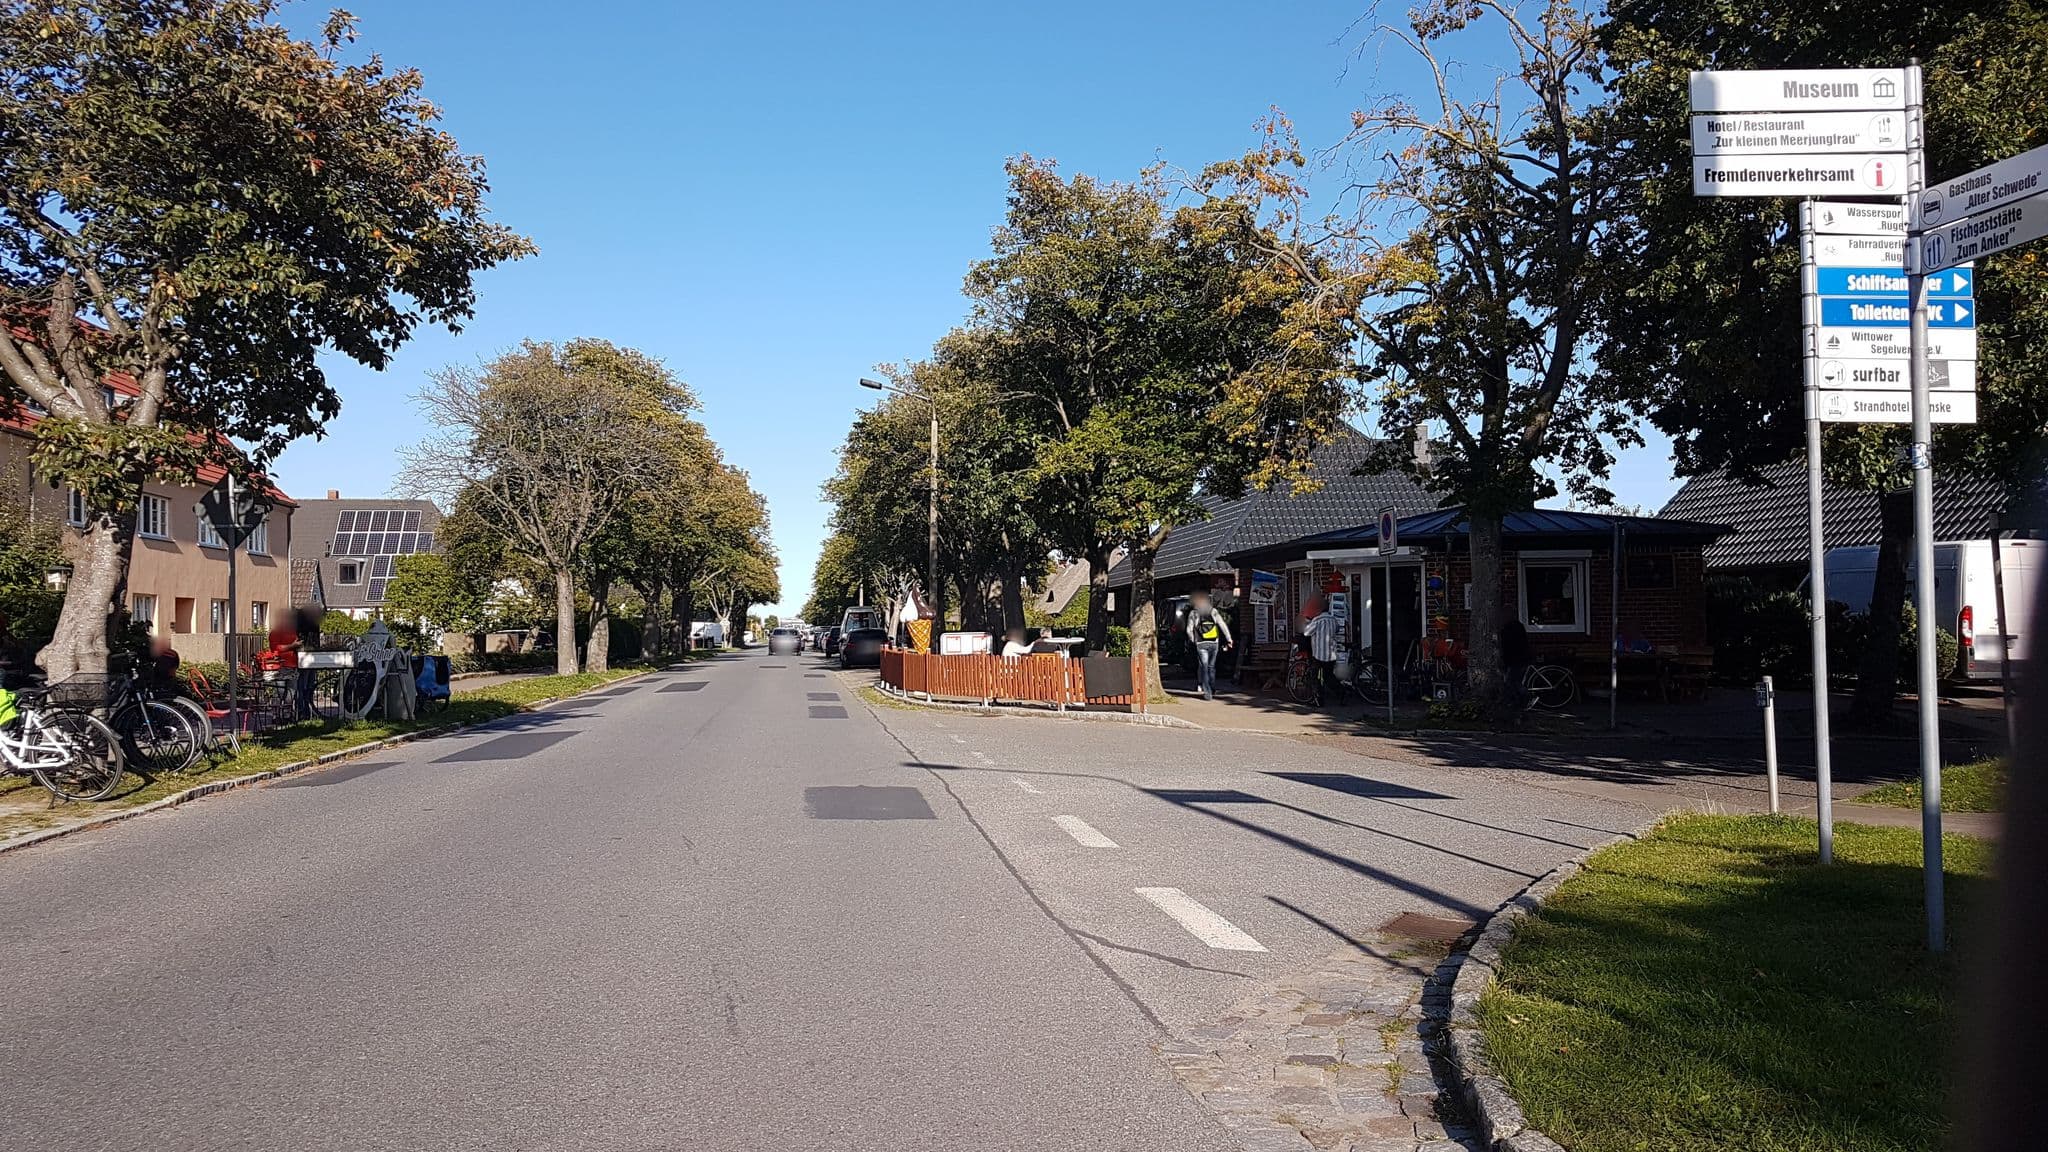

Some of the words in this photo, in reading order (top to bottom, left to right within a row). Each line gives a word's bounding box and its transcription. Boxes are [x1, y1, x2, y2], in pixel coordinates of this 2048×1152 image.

[1783, 81, 1859, 98] Museum
[1736, 135, 1778, 147] kleinen
[1704, 168, 1855, 183] Fremdenverkehrsamt
[1949, 173, 1992, 198] Gasthaus
[1847, 207, 1902, 219] Wasserspor
[1950, 208, 2023, 244] Fischgaststätte
[1848, 239, 1904, 249] Fahrradverl
[1850, 303, 1909, 321] Toiletten
[1851, 331, 1893, 342] Wittower
[1852, 367, 1901, 383] surfbar
[1854, 401, 1910, 412] Strandhotel
